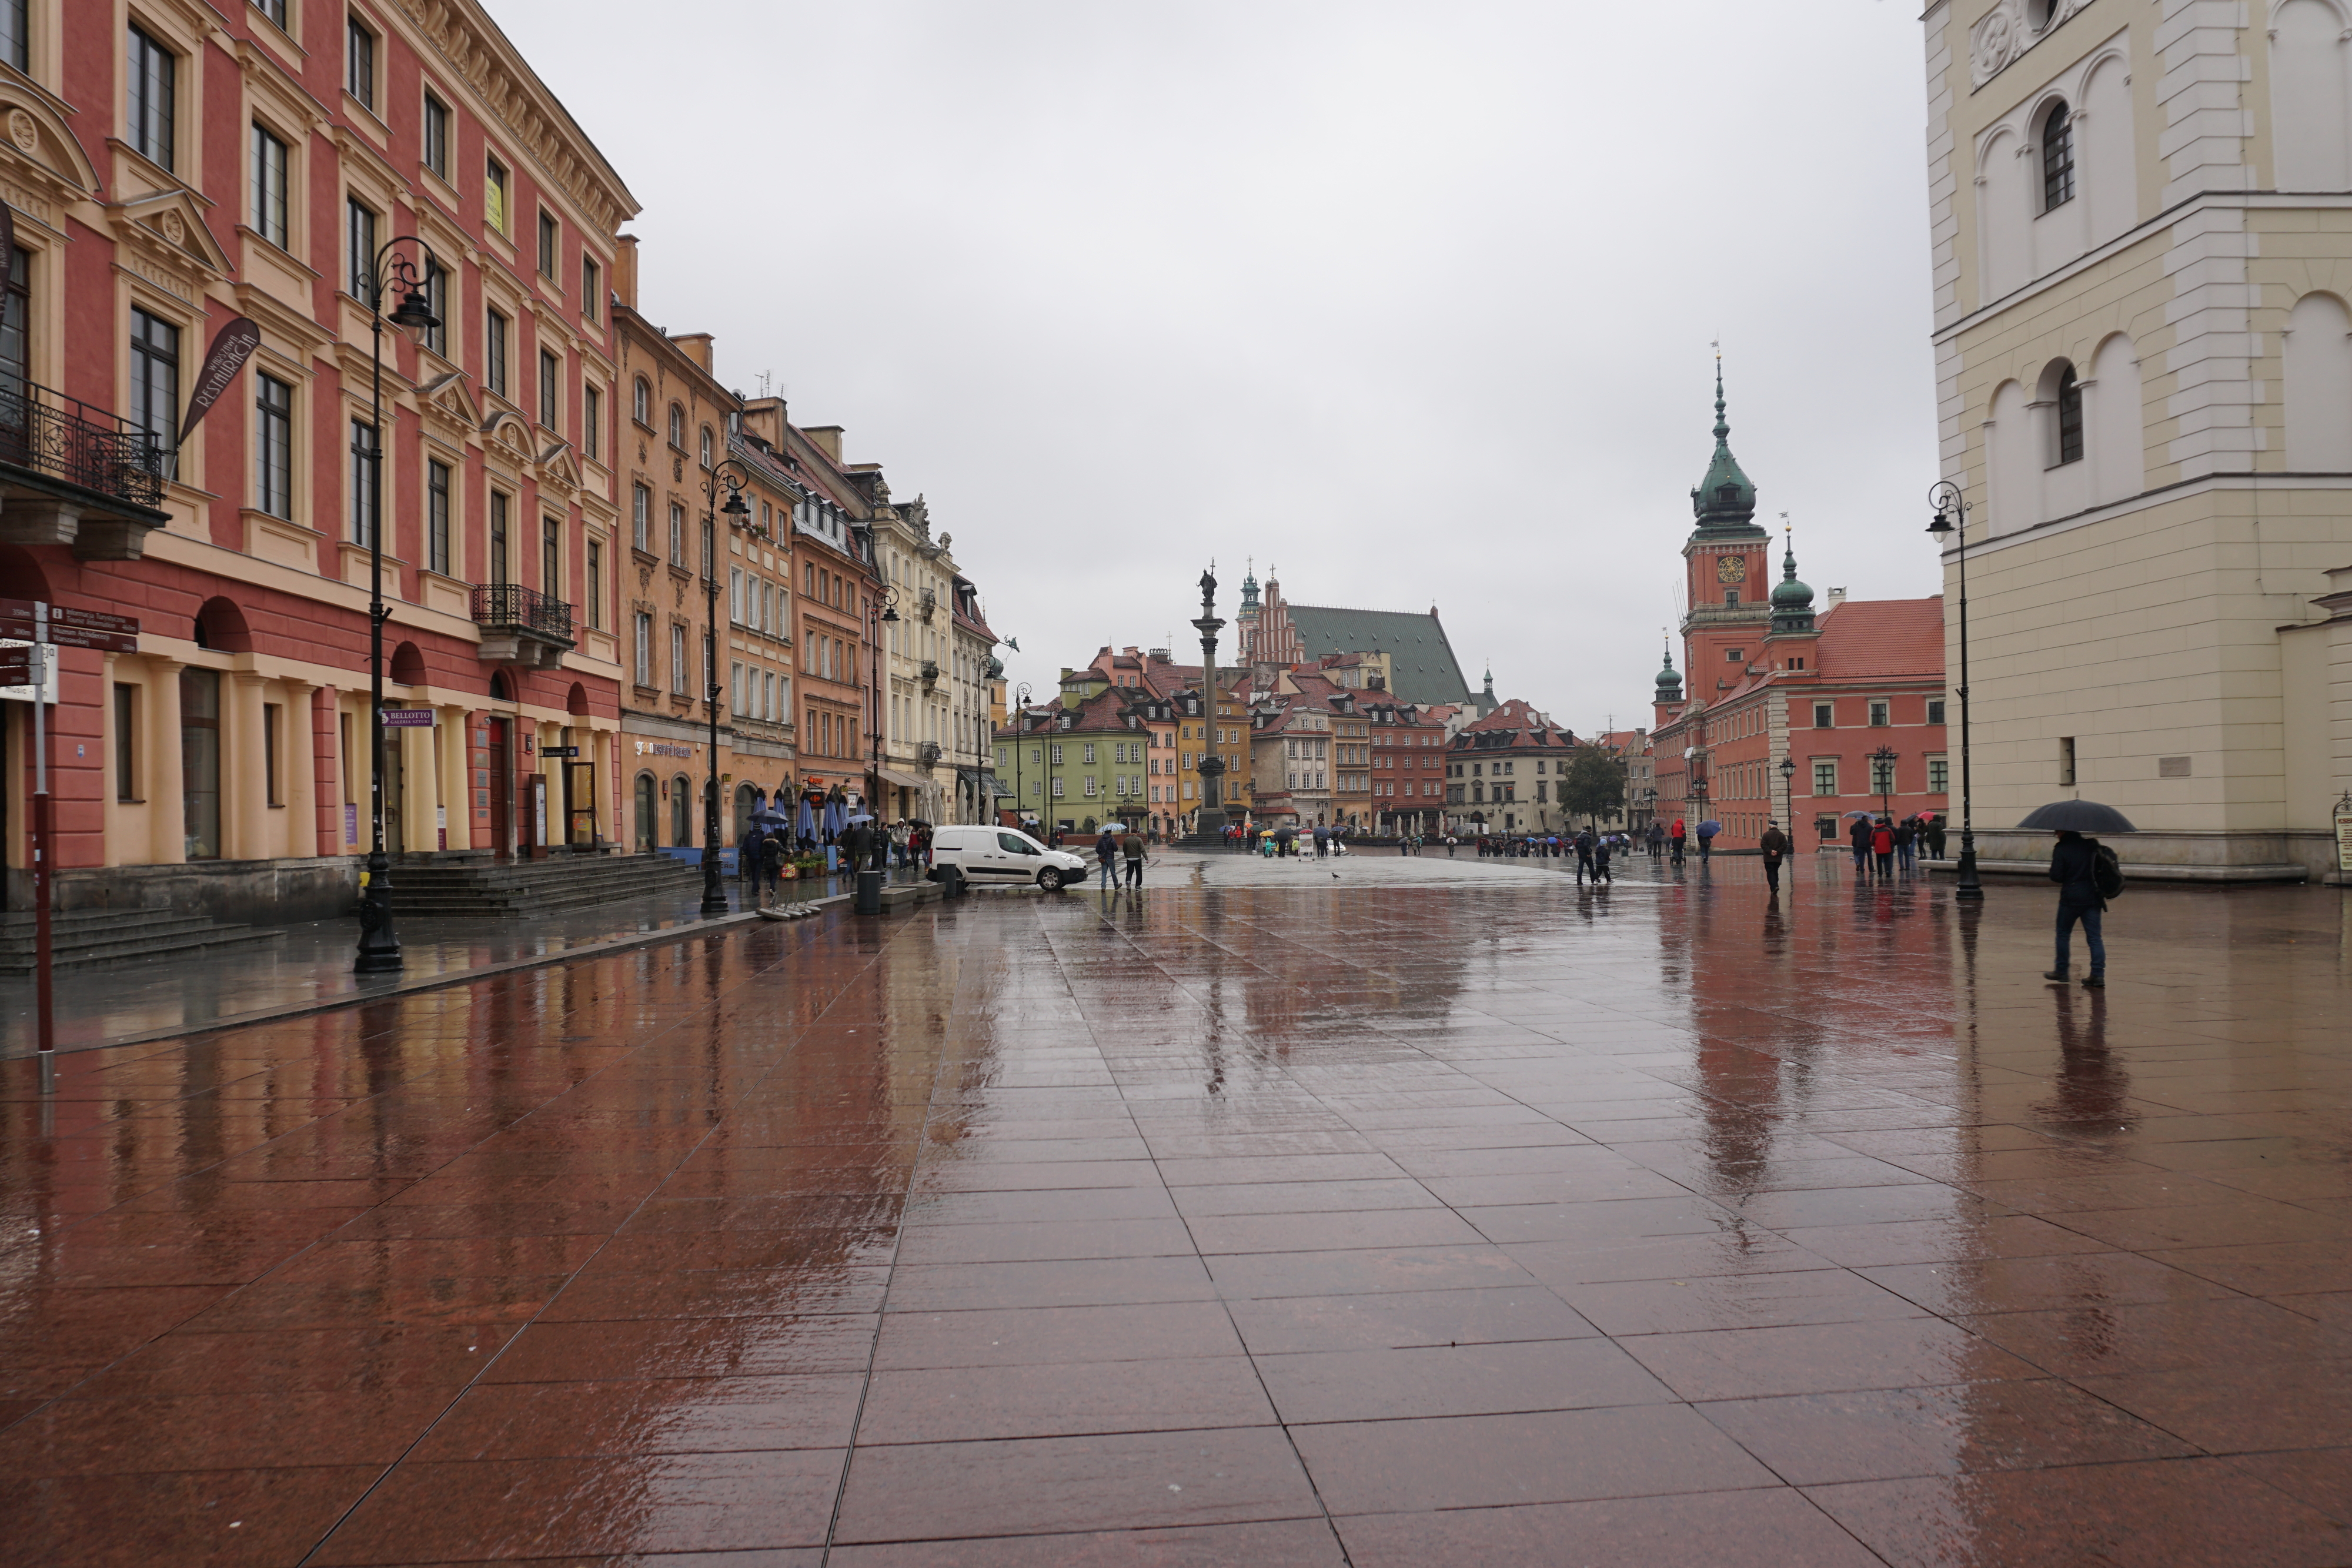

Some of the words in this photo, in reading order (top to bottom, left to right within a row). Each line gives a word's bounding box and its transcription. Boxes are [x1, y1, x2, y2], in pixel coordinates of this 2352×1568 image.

[207, 335, 238, 371] WARSZAWA
[195, 333, 257, 407] RESTAURACJA
[65, 609, 94, 619] Informacja
[96, 613, 126, 623] Turystyczna
[66, 616, 85, 624] Tourist
[86, 618, 116, 629] Information
[13, 627, 31, 636] 300m
[52, 627, 76, 636] Muzeum
[78, 630, 110, 641] Archidiecezji
[52, 634, 89, 647] Warszawskiej
[635, 741, 654, 755] green
